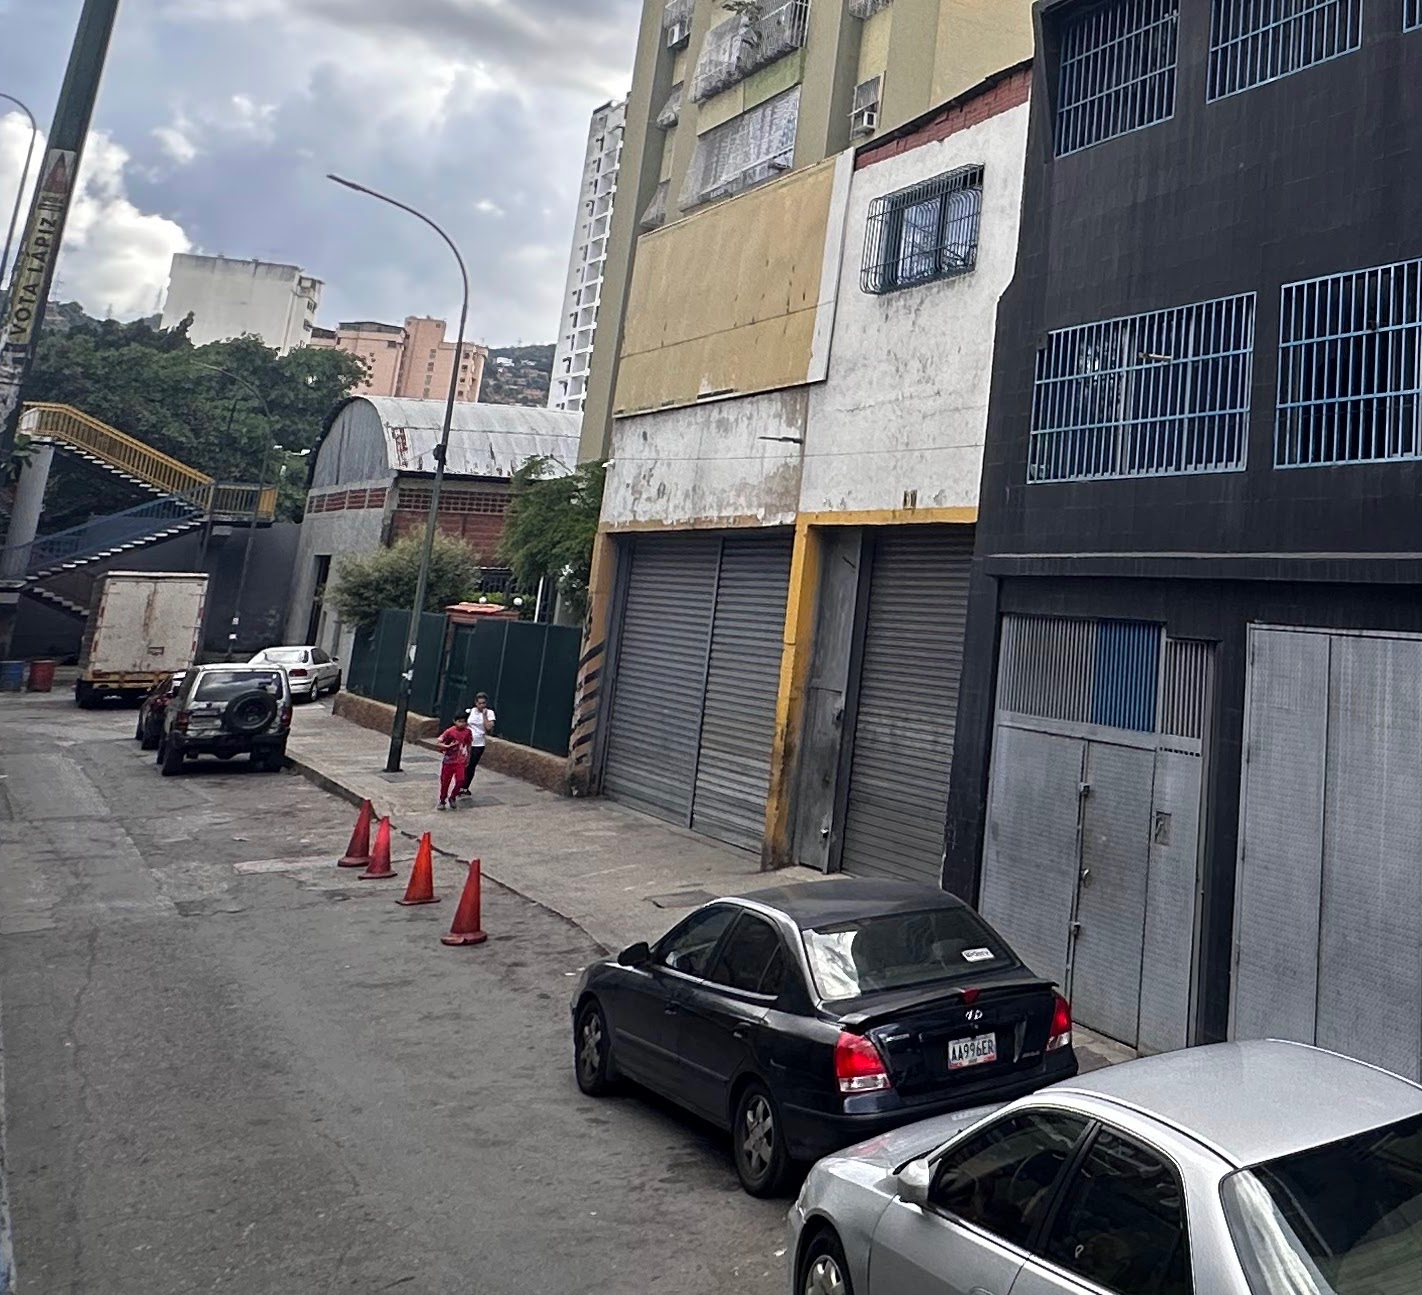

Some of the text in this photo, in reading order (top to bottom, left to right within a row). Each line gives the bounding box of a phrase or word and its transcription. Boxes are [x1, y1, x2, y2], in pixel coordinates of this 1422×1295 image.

[10, 217, 57, 336] VOTA LÁPIZ
[951, 1039, 995, 1062] AA996ER
